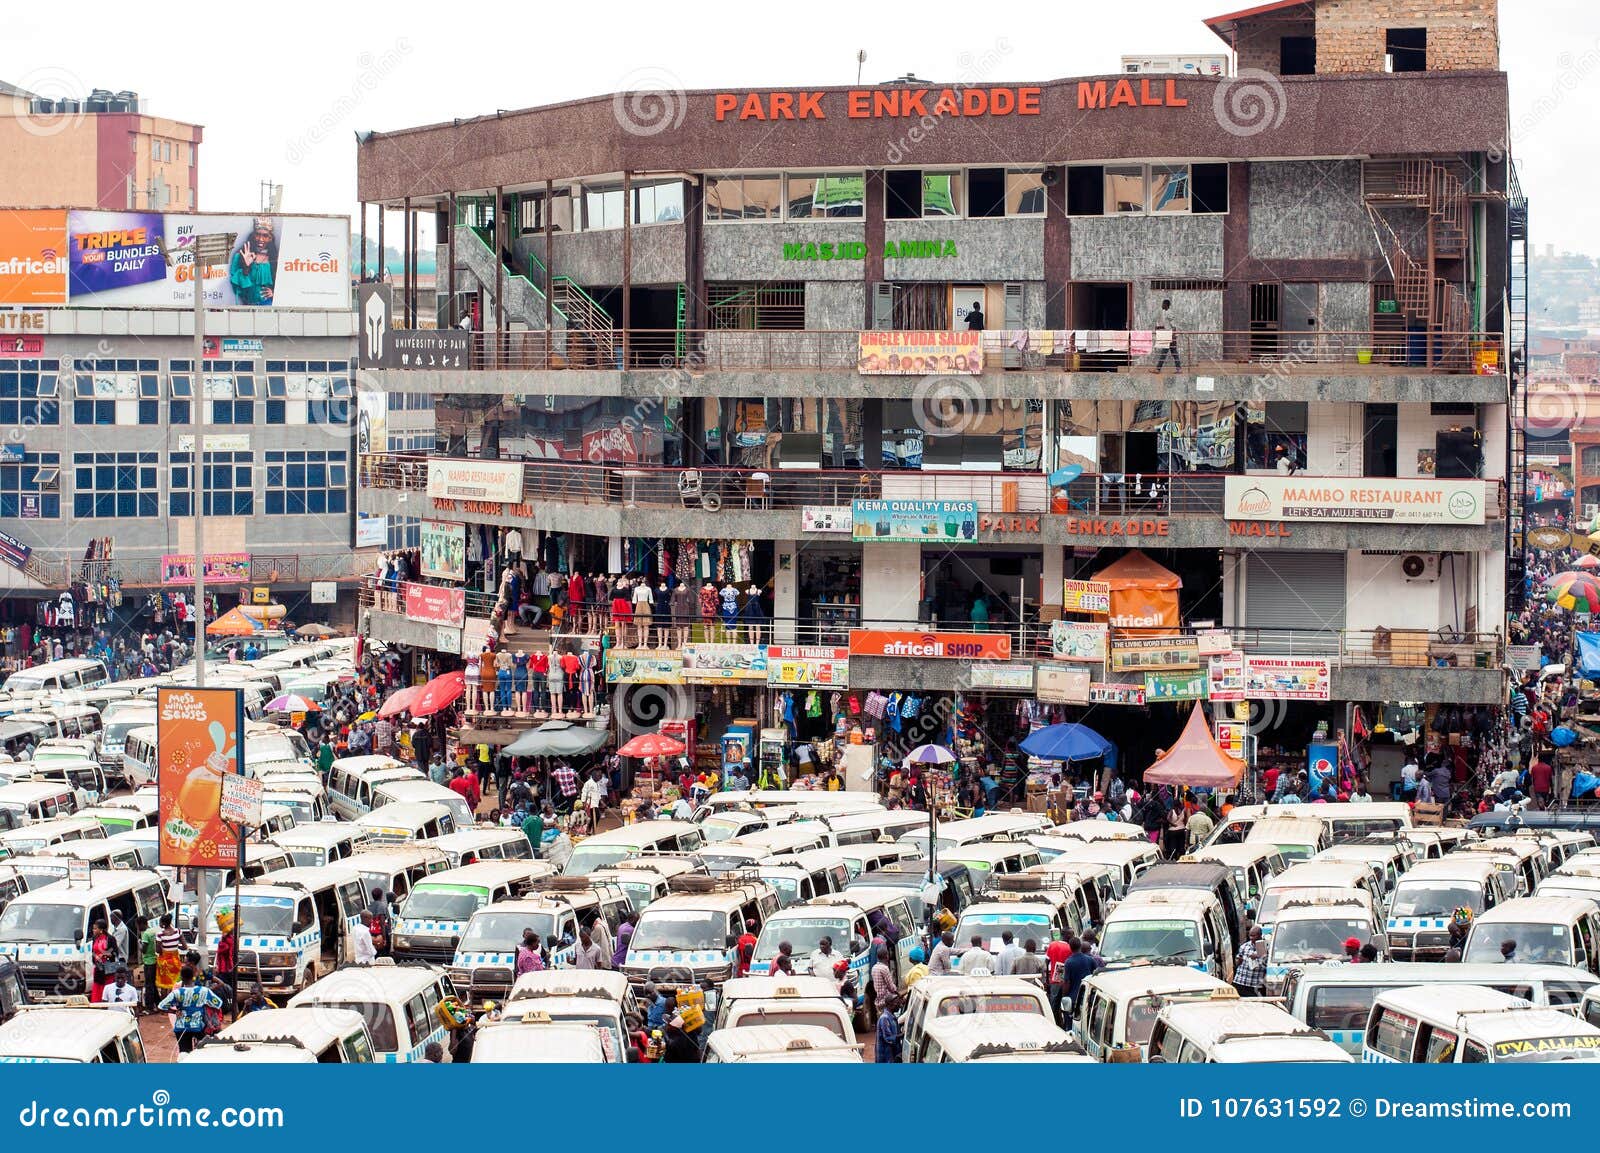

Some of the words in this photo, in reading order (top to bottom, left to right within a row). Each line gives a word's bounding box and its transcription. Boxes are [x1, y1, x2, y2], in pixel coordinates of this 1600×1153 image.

[715, 91, 826, 121] PARK
[848, 86, 1042, 118] ENKADDE
[1077, 79, 1188, 109] MALL
[74, 226, 147, 249] TRIPLE
[177, 225, 194, 235] BUY
[82, 253, 105, 264] YOUR
[106, 245, 160, 261] BUNDLES
[783, 241, 868, 261] MASJID
[883, 239, 958, 259] AMINA
[114, 258, 146, 273] DAILY
[283, 257, 339, 273] africell
[395, 338, 435, 349] UNIVERSITY
[438, 339, 447, 349] OF
[450, 340, 466, 350] PAIN
[860, 331, 900, 346] UNCLE
[901, 331, 937, 346] YUDA
[939, 331, 979, 346] SALON
[447, 469, 470, 482] MAMBO
[471, 470, 506, 484] RESTAURANT
[1283, 488, 1344, 503] MAMBO
[1350, 489, 1443, 504] RESTAURANT
[432, 498, 457, 511] PARK
[463, 500, 503, 516] ENKADDE
[509, 503, 534, 517] MALL
[857, 501, 889, 511] KEMA
[892, 502, 941, 512] QUALITY
[943, 502, 974, 512] BAGS
[1289, 508, 1310, 517] LET'S
[1332, 508, 1360, 518] MUJJE
[980, 515, 1040, 532] PARK
[1068, 518, 1169, 536] ENKADDE
[1229, 521, 1292, 537] MALL
[1066, 581, 1085, 592] PHOTO
[1086, 582, 1108, 593] STUDIO
[883, 640, 943, 656] africell
[946, 643, 983, 657] SHOP
[1176, 638, 1197, 646] CENTRE
[781, 647, 799, 658] ECHI
[800, 648, 835, 659] TRADERS
[1249, 659, 1288, 667] KIWATULE
[218, 849, 238, 858] TASTE
